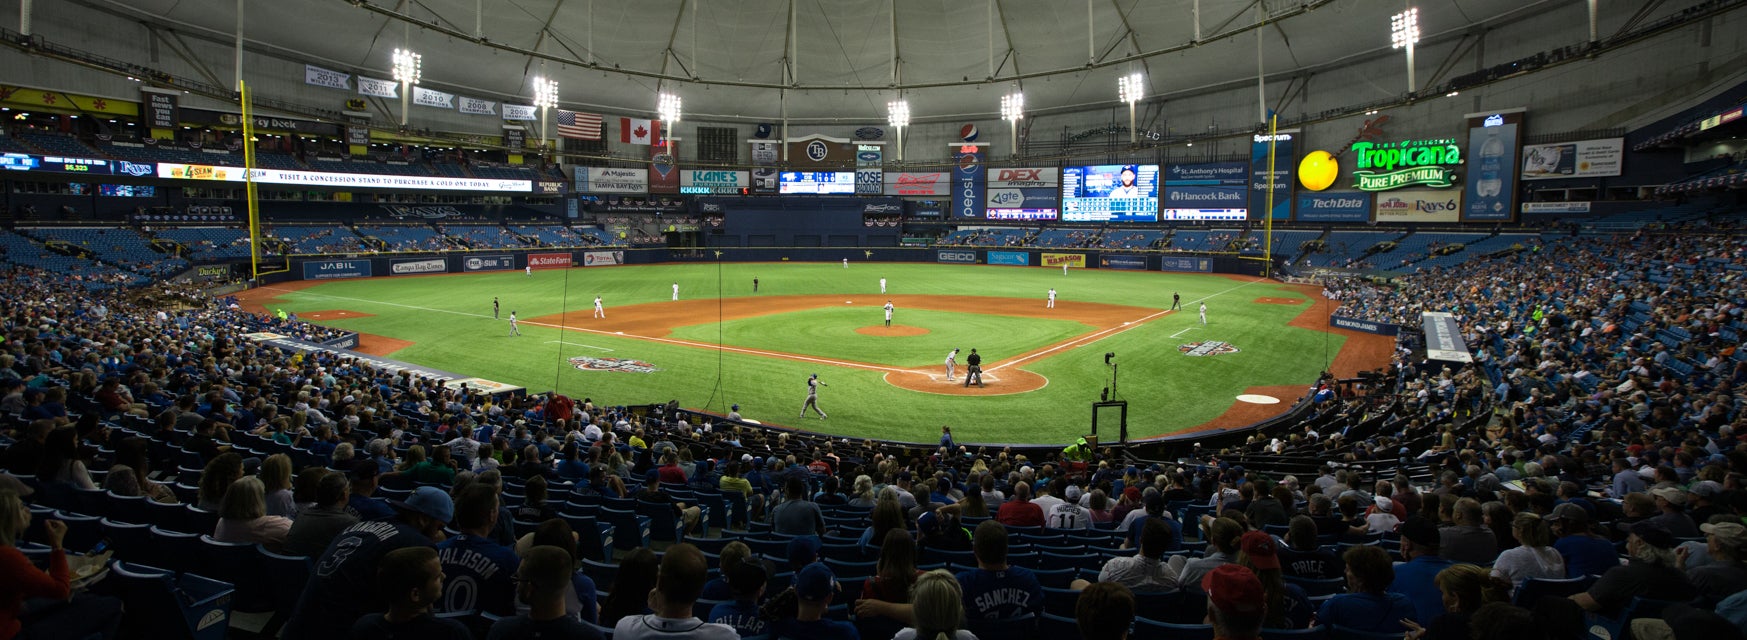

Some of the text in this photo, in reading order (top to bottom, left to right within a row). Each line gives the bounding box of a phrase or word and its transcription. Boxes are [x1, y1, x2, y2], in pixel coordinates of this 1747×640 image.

[317, 73, 339, 83] 2013
[368, 83, 388, 91] 2011
[152, 94, 169, 103] Fast
[422, 93, 444, 102] 2010
[416, 98, 449, 108] CHAMPIONS
[467, 102, 487, 110] 2008
[155, 108, 170, 116] you
[461, 107, 492, 115] CHAMPIONS
[510, 108, 528, 116] 2008
[271, 118, 296, 128] Deck
[1254, 134, 1290, 143] Specrum
[1412, 138, 1456, 147] ORIGINAL
[811, 144, 825, 158] TB
[1352, 141, 1460, 171] Tropicana
[611, 170, 636, 178] Majestic
[692, 170, 738, 183] KANE'S
[857, 171, 881, 183] ROSE
[998, 169, 1042, 181] DEX
[1189, 168, 1218, 176] Anthony's
[279, 173, 301, 181] VISIT
[309, 175, 356, 183] CONCESSION
[1360, 169, 1444, 188] PURE PREMIUM
[857, 183, 881, 194] RADIOLOGY
[1254, 182, 1287, 190] Specrum
[962, 176, 976, 217] pepsi
[1001, 191, 1019, 202] gte
[1180, 191, 1241, 201] Hancock Bank
[1445, 199, 1457, 211] 6
[939, 252, 975, 261] GEICO
[320, 262, 356, 270] JABIL
[395, 262, 443, 272] Tampa Bay Times
[484, 259, 498, 267] SUN
[199, 265, 227, 277] Ducky's
[1336, 318, 1377, 331] RAYMOND JAMES
[1056, 505, 1081, 515] HUGHES
[1059, 513, 1076, 529] 11
[317, 536, 363, 576] 3
[1291, 560, 1326, 575] PRICE
[975, 587, 1031, 613] SANCHEZ
